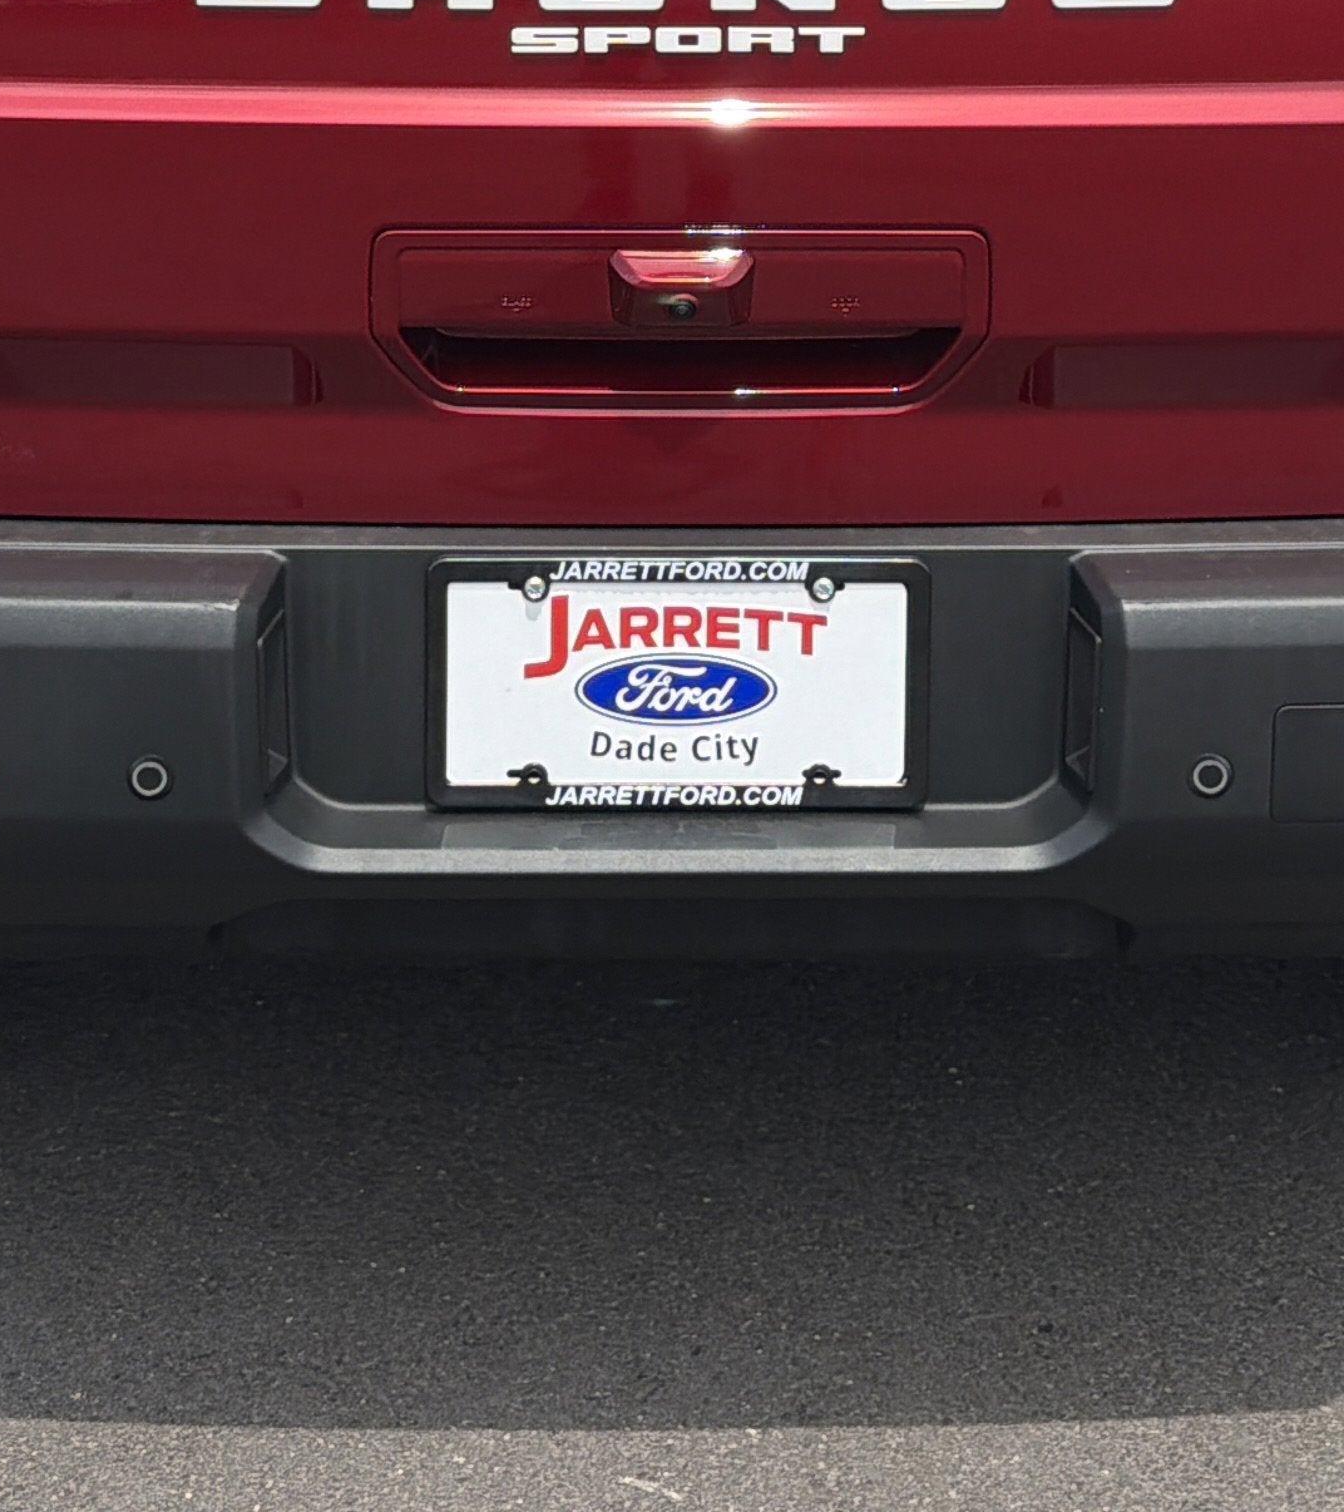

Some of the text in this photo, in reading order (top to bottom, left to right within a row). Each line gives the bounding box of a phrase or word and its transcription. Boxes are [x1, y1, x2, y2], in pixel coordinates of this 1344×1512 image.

[509, 25, 866, 55] SPORT
[548, 560, 810, 582] JARRETTFORD.COM
[524, 594, 828, 679] JARRETT
[615, 662, 737, 712] Ford
[589, 730, 759, 766] Dade City
[544, 784, 805, 807] JARRETTFORD.COM
